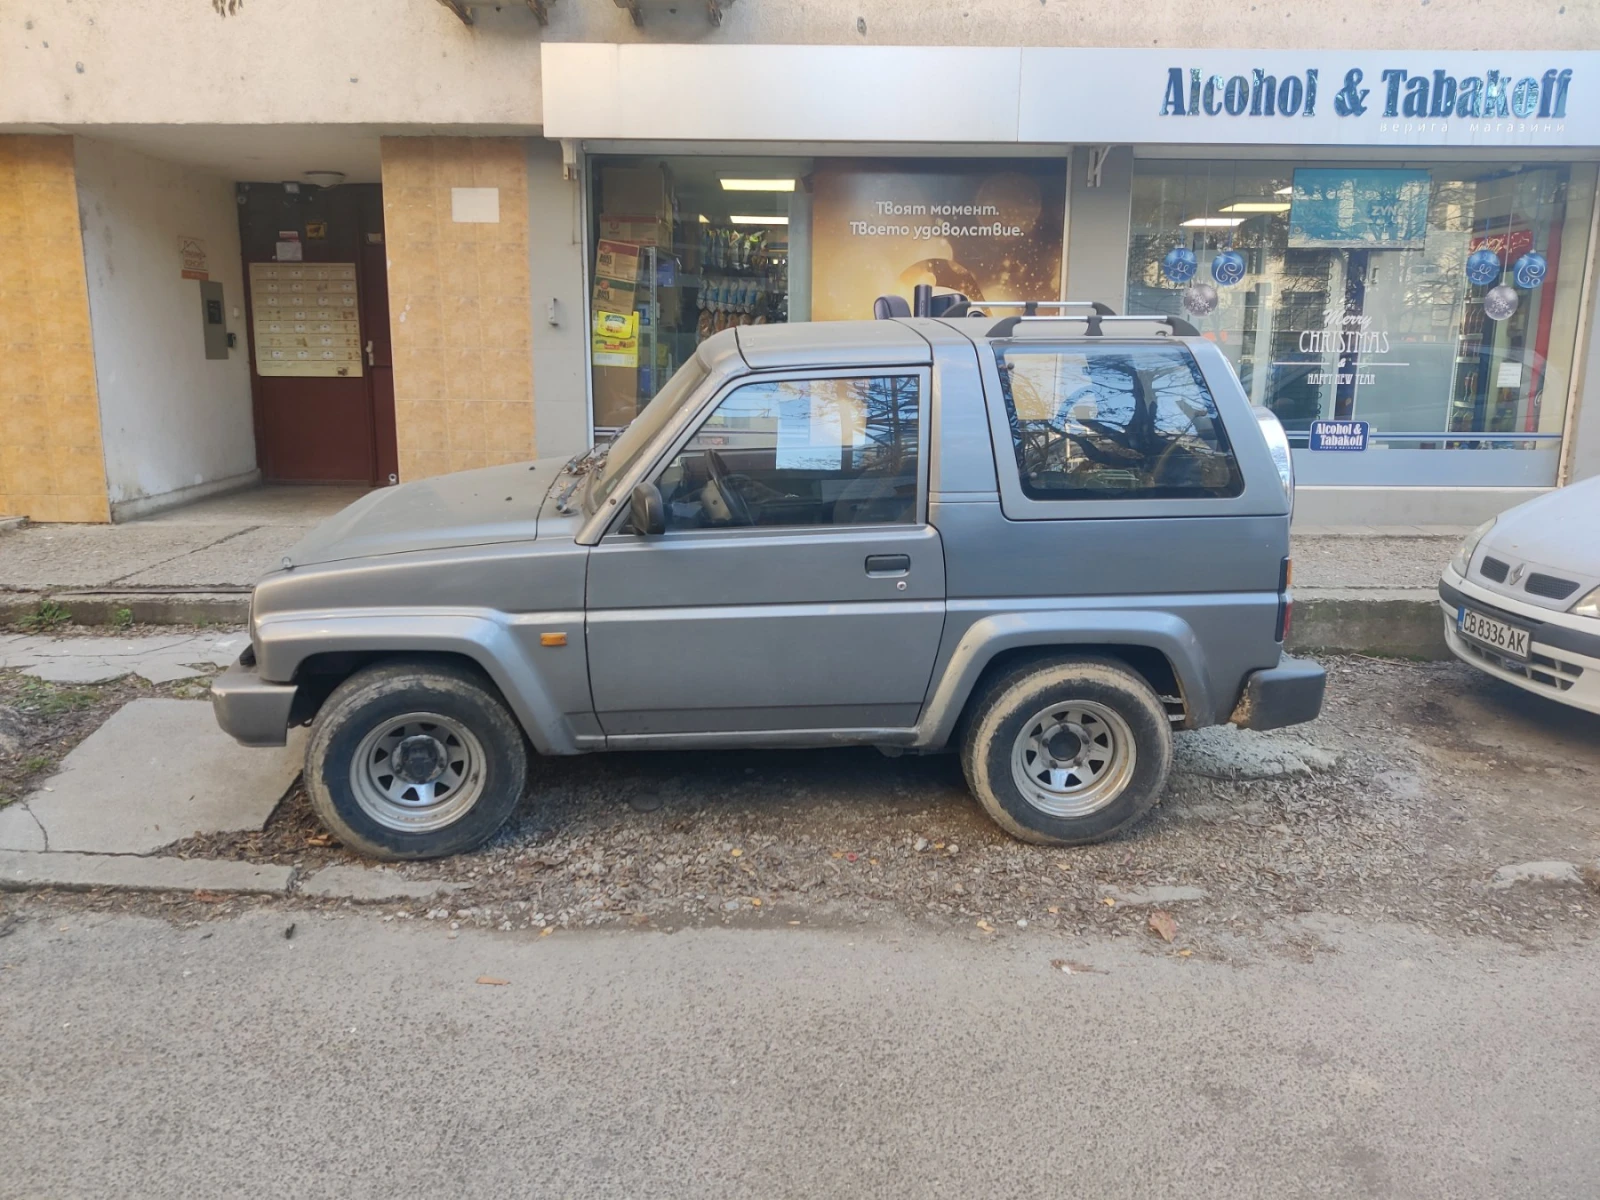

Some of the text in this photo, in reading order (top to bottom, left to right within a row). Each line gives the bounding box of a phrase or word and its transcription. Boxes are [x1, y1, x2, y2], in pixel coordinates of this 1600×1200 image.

[1159, 67, 1573, 119] Alcohol & Tabakoff
[1379, 121, 1565, 135] верига магазини
[875, 201, 1000, 216] Твоят момент.
[850, 221, 1025, 240] Твоето удоволствие.
[1322, 309, 1373, 330] Merry
[1299, 330, 1390, 354] CHRISTMAS
[1307, 373, 1376, 385] HAPPY NEW YEAR
[1315, 423, 1362, 435] Alcohol &
[1320, 434, 1364, 446] Tabakoff
[1463, 612, 1526, 654] CB 8336 AK
